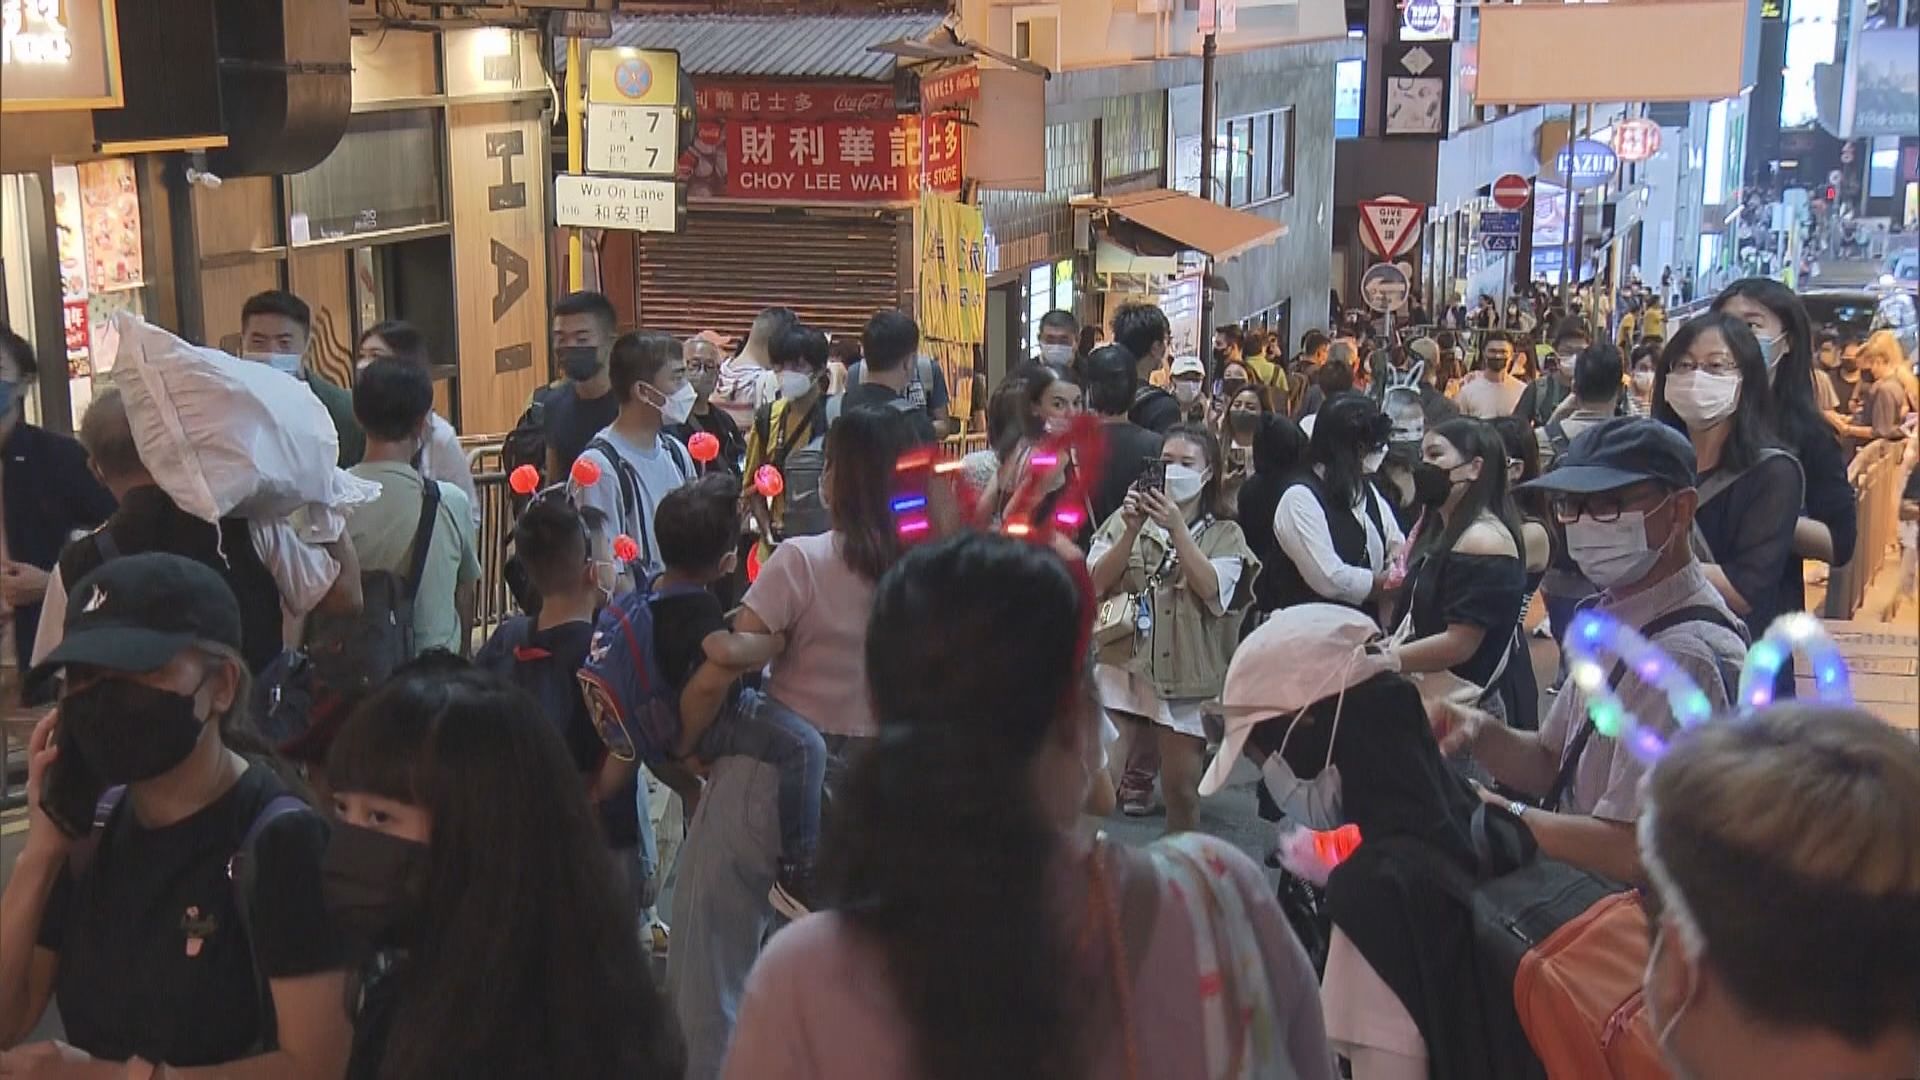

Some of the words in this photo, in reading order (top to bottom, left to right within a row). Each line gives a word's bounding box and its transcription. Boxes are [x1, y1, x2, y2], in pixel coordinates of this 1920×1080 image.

[646, 112, 660, 133] 7
[645, 147, 659, 168] 7
[740, 172, 795, 190] CHOY
[805, 173, 841, 190] LEE
[851, 174, 897, 191] WAH
[933, 164, 957, 186] STORE
[581, 183, 601, 196] Wo
[608, 185, 626, 199] On
[633, 186, 665, 201] Lane
[595, 203, 650, 224] 和安里
[1379, 208, 1402, 217] GIVE
[1379, 218, 1402, 226] WAY
